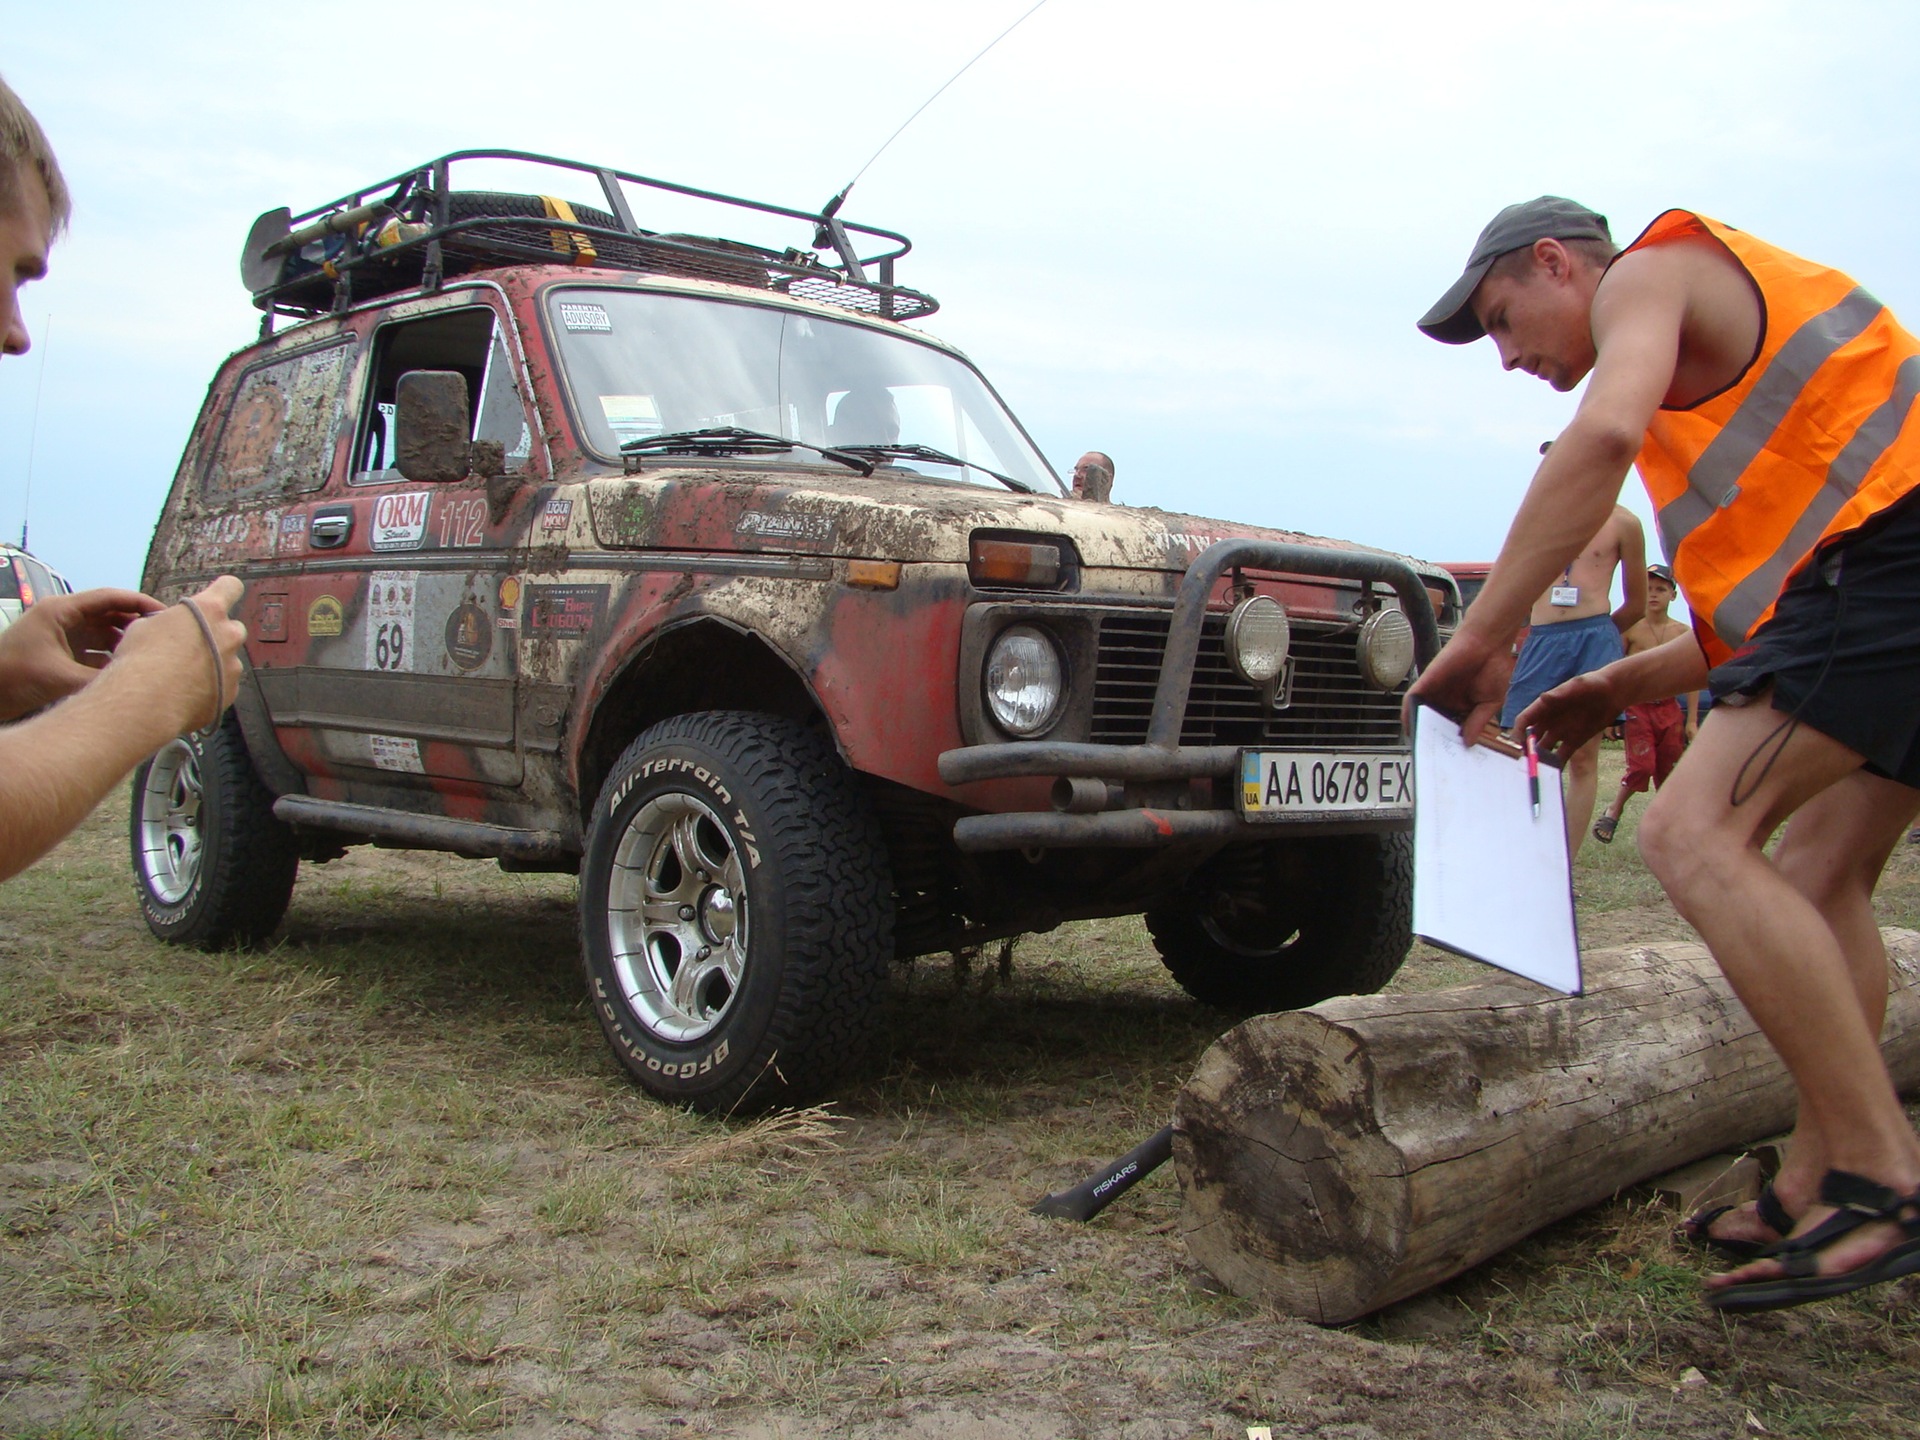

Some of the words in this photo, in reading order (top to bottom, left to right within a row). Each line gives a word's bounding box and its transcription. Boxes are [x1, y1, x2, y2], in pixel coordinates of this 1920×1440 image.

[560, 303, 604, 312] PARENTAL
[565, 311, 607, 325] ADVISORY
[379, 494, 427, 528] ORM
[546, 503, 570, 514] LIQUI
[440, 498, 488, 547] 112
[544, 515, 567, 527] MOLY
[383, 529, 411, 540] Studio
[498, 619, 517, 628] Shell
[377, 624, 403, 669] 69
[1265, 761, 1303, 805] AA
[1312, 761, 1369, 804] 0678
[1379, 761, 1411, 803] EX
[1245, 792, 1259, 806] UA
[609, 757, 732, 818] All-Terrain
[733, 808, 762, 870] T/A
[594, 976, 730, 1080] BFGoodrich
[1092, 1161, 1138, 1198] FISKARS
